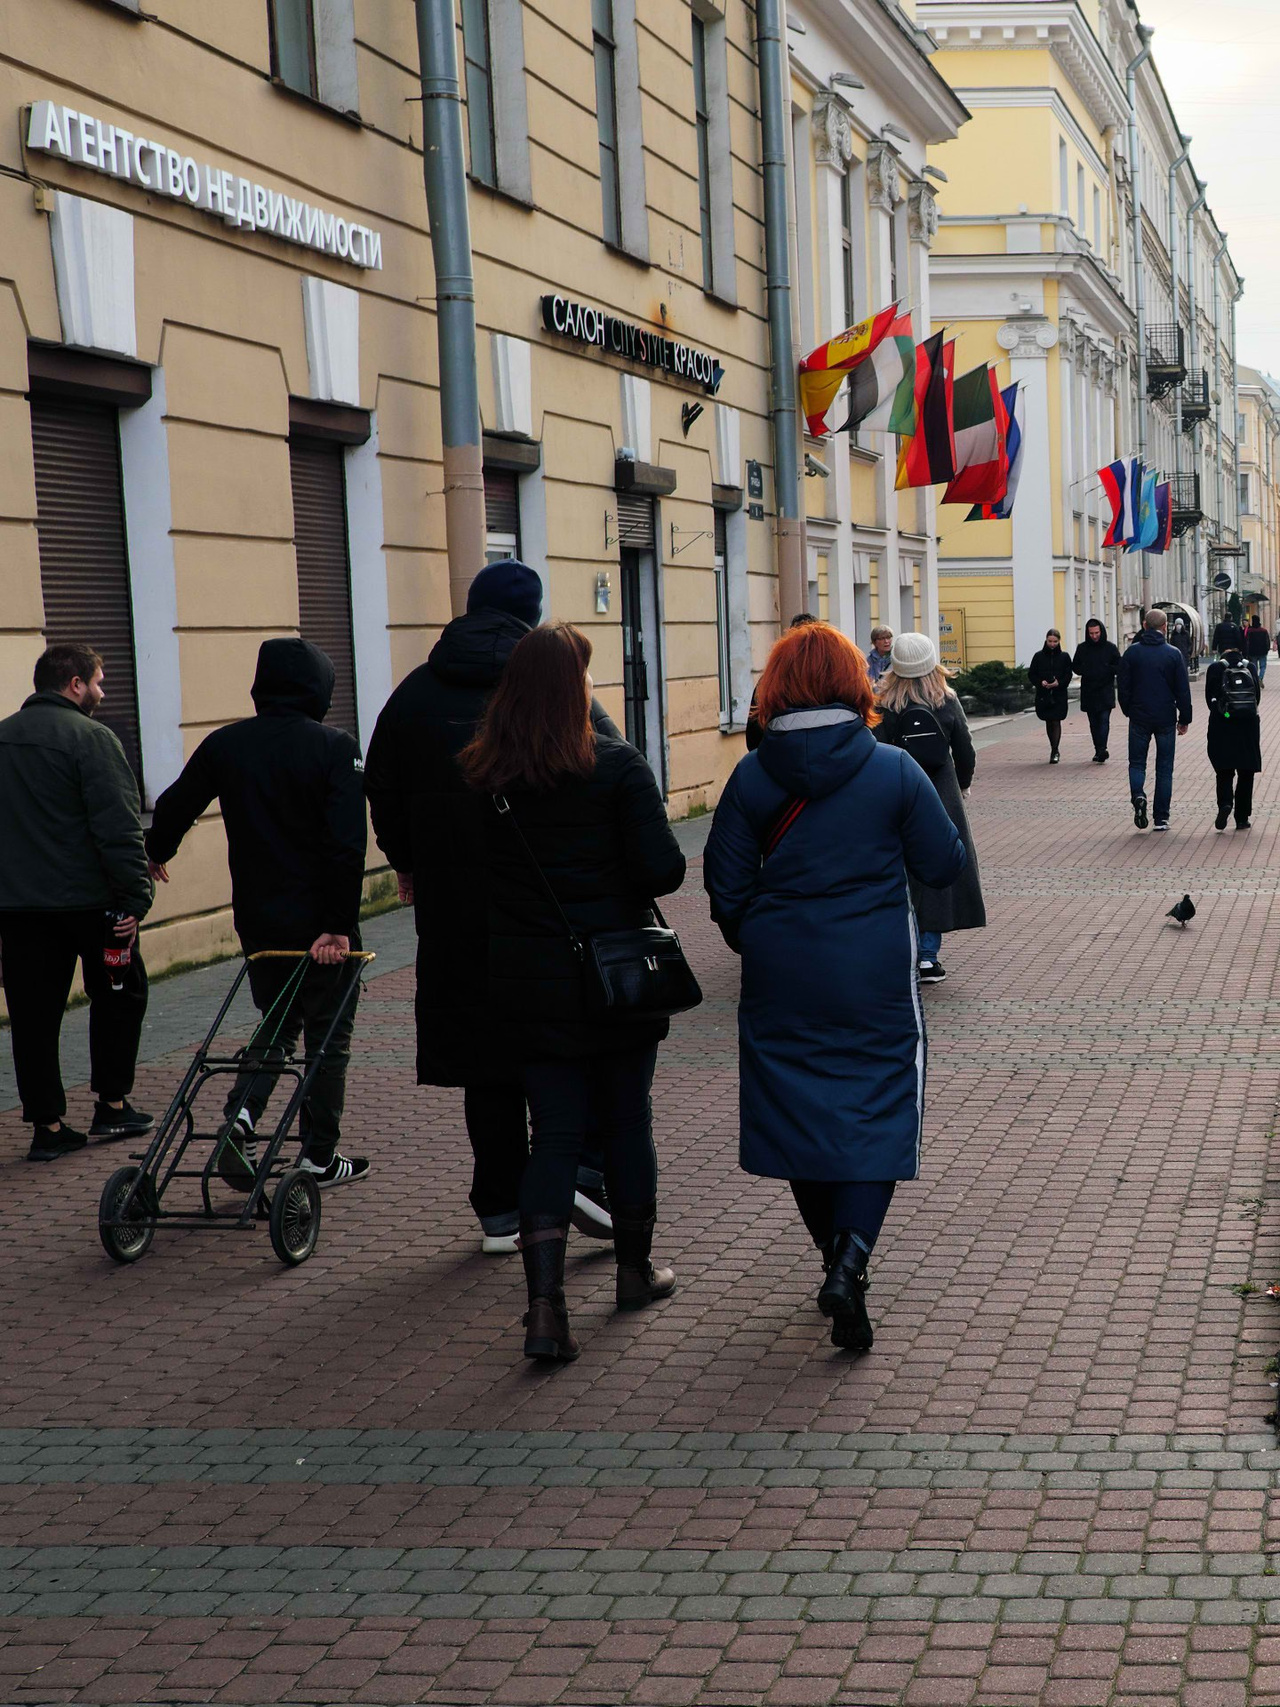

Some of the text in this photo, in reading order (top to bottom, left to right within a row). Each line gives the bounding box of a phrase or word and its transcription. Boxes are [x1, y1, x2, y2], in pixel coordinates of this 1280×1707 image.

[42, 101, 383, 270] АГЕНТСТВО НЕДВИЖИМОСТИ
[552, 295, 605, 346] САЛОН
